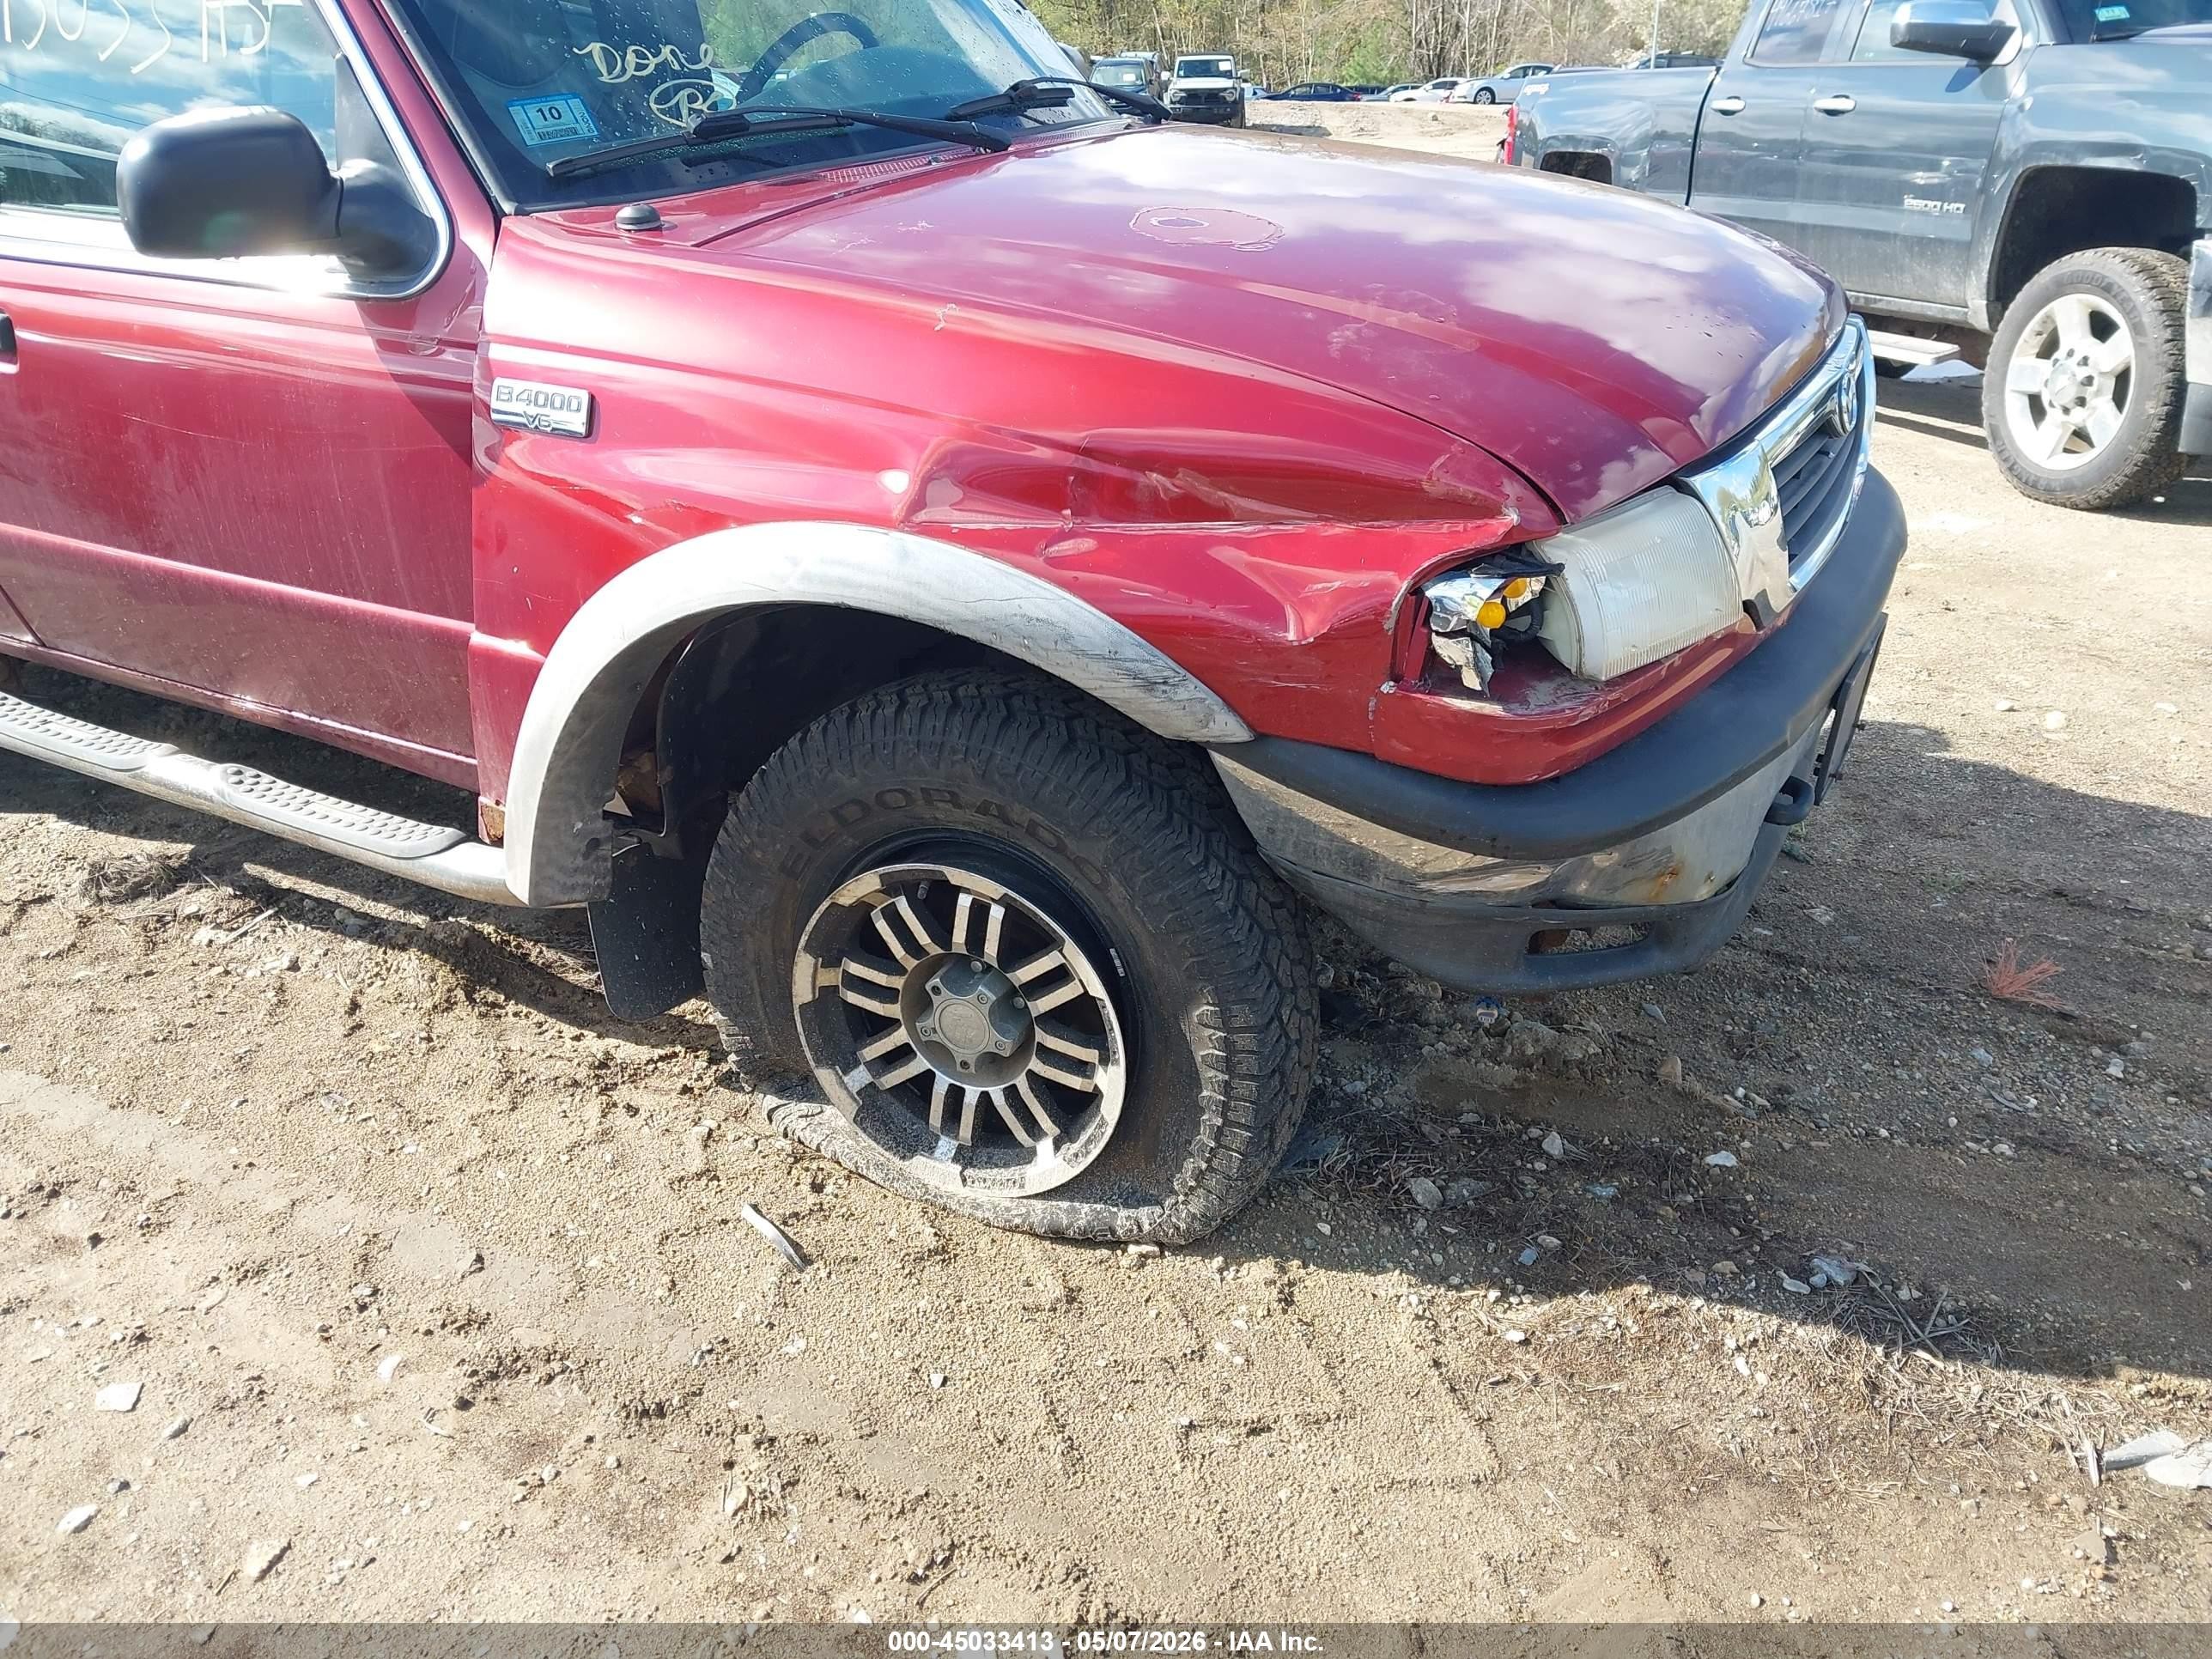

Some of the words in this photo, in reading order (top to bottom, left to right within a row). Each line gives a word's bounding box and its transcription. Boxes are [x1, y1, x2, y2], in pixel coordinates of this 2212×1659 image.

[536, 106, 562, 122] 10
[1904, 198, 1942, 212] 2500
[1943, 202, 1966, 214] HD
[495, 385, 582, 413] B4000
[523, 410, 552, 432] V6
[780, 786, 1110, 886] ELDORADO
